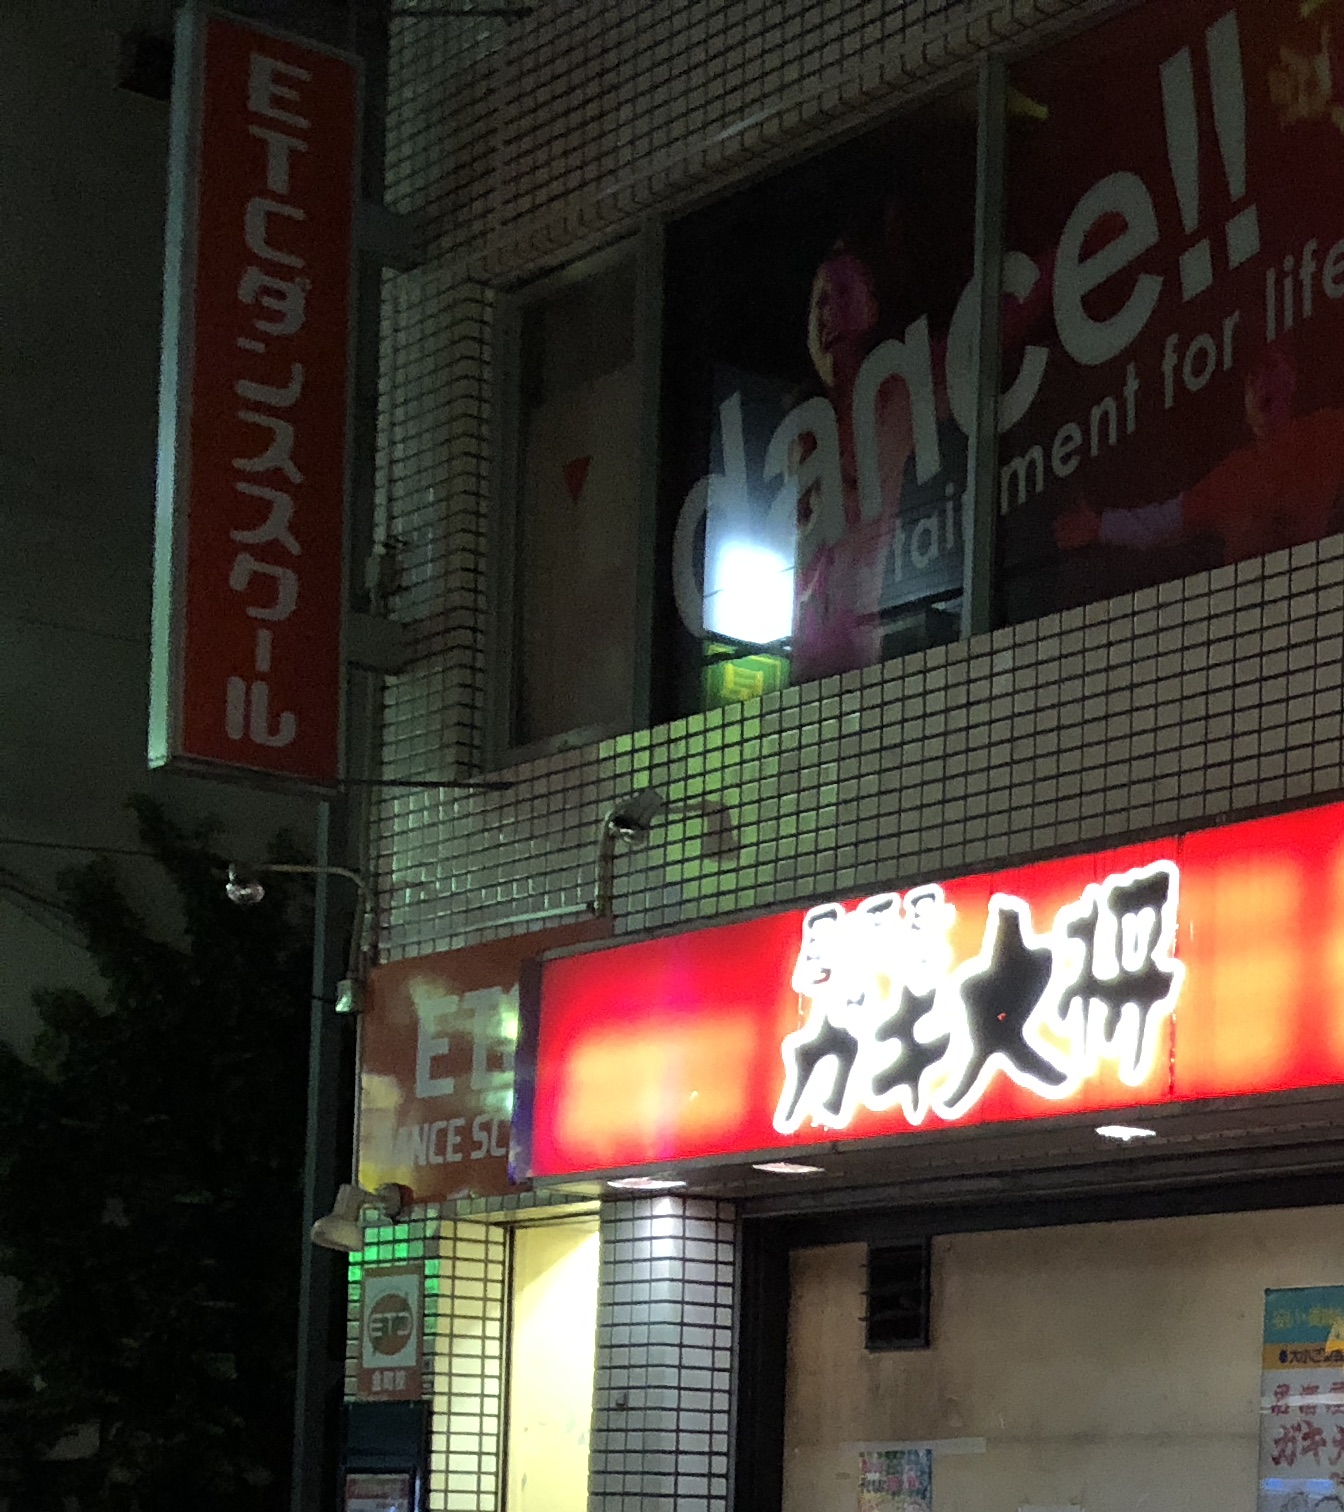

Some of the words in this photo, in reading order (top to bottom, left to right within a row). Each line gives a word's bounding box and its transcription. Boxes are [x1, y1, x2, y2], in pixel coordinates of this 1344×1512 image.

[225, 53, 312, 748] ETCダンススクール
[1163, 309, 1240, 411] for
